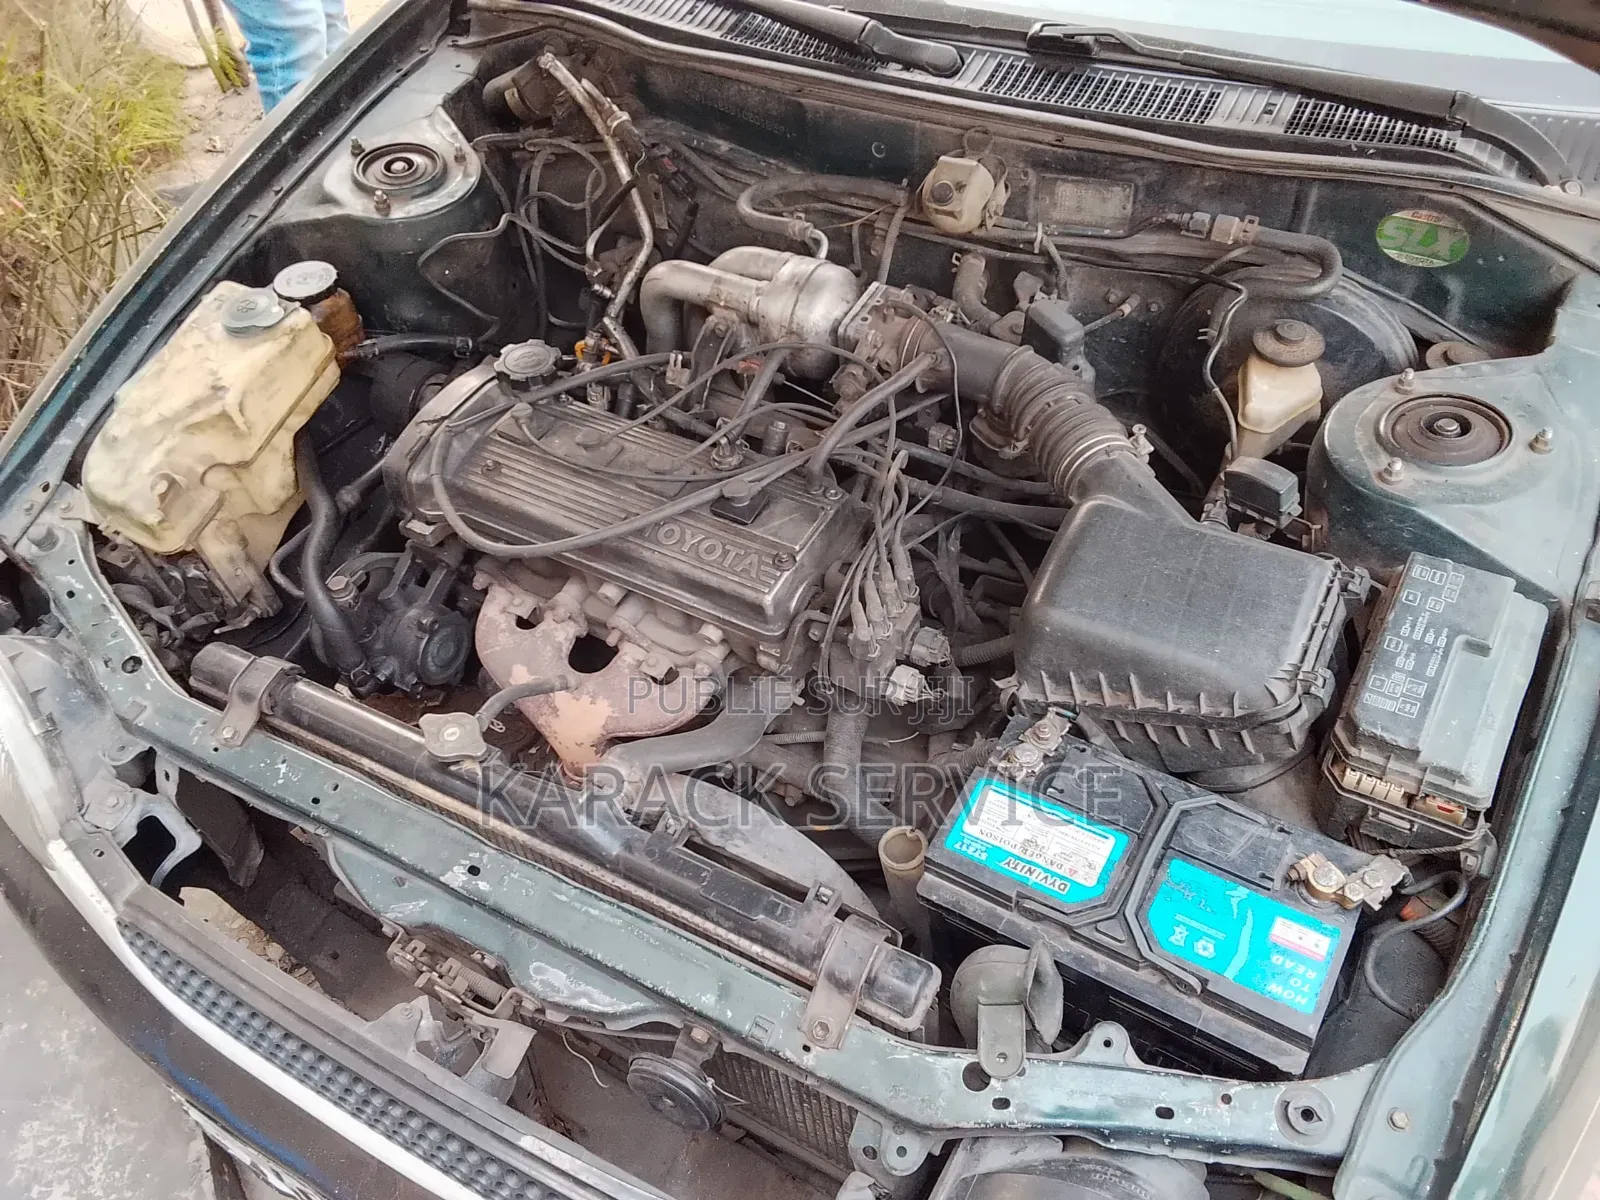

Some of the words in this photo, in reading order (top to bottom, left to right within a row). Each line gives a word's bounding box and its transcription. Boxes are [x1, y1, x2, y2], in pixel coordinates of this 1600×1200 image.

[1378, 219, 1466, 261] SLX
[1001, 856, 1070, 894] DYVINITY
[1270, 953, 1318, 981] READ
[1266, 982, 1309, 1006] HOW
[1288, 977, 1312, 993] TO
